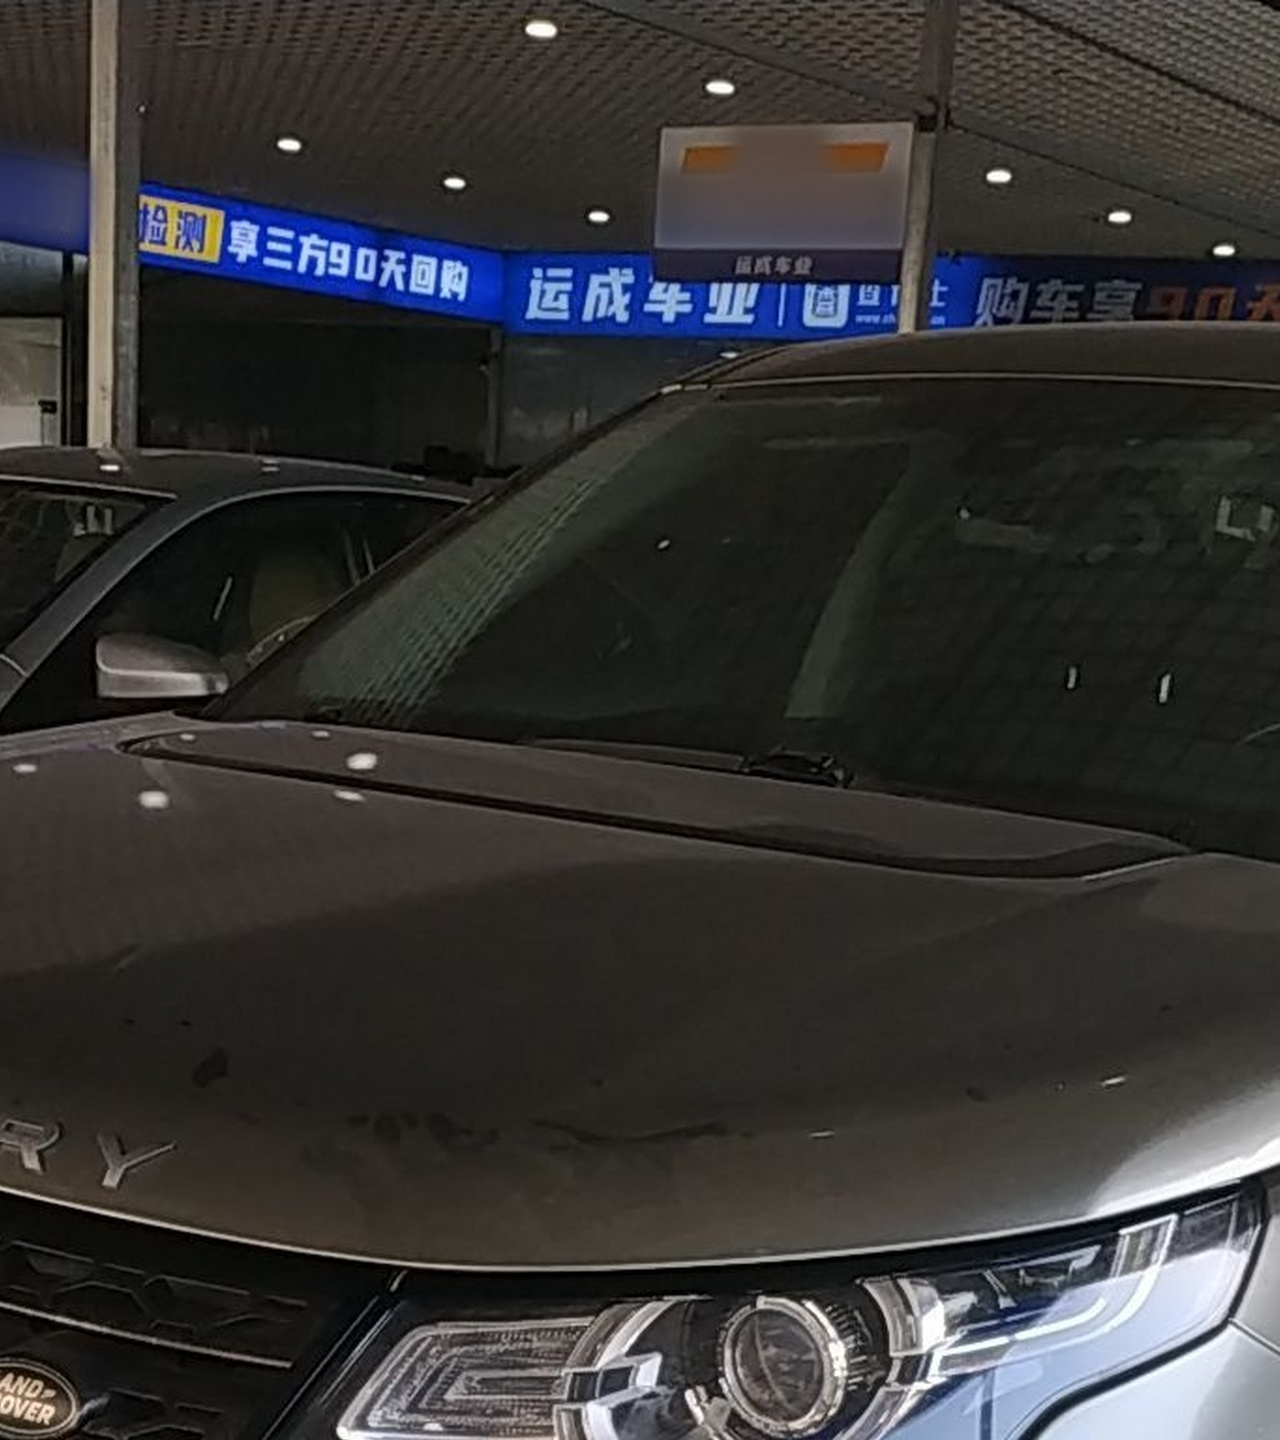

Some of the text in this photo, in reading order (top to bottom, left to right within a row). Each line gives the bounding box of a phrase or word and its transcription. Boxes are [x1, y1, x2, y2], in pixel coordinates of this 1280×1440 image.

[227, 220, 468, 302] 享三方90天回购
[524, 267, 759, 324] 运成车业
